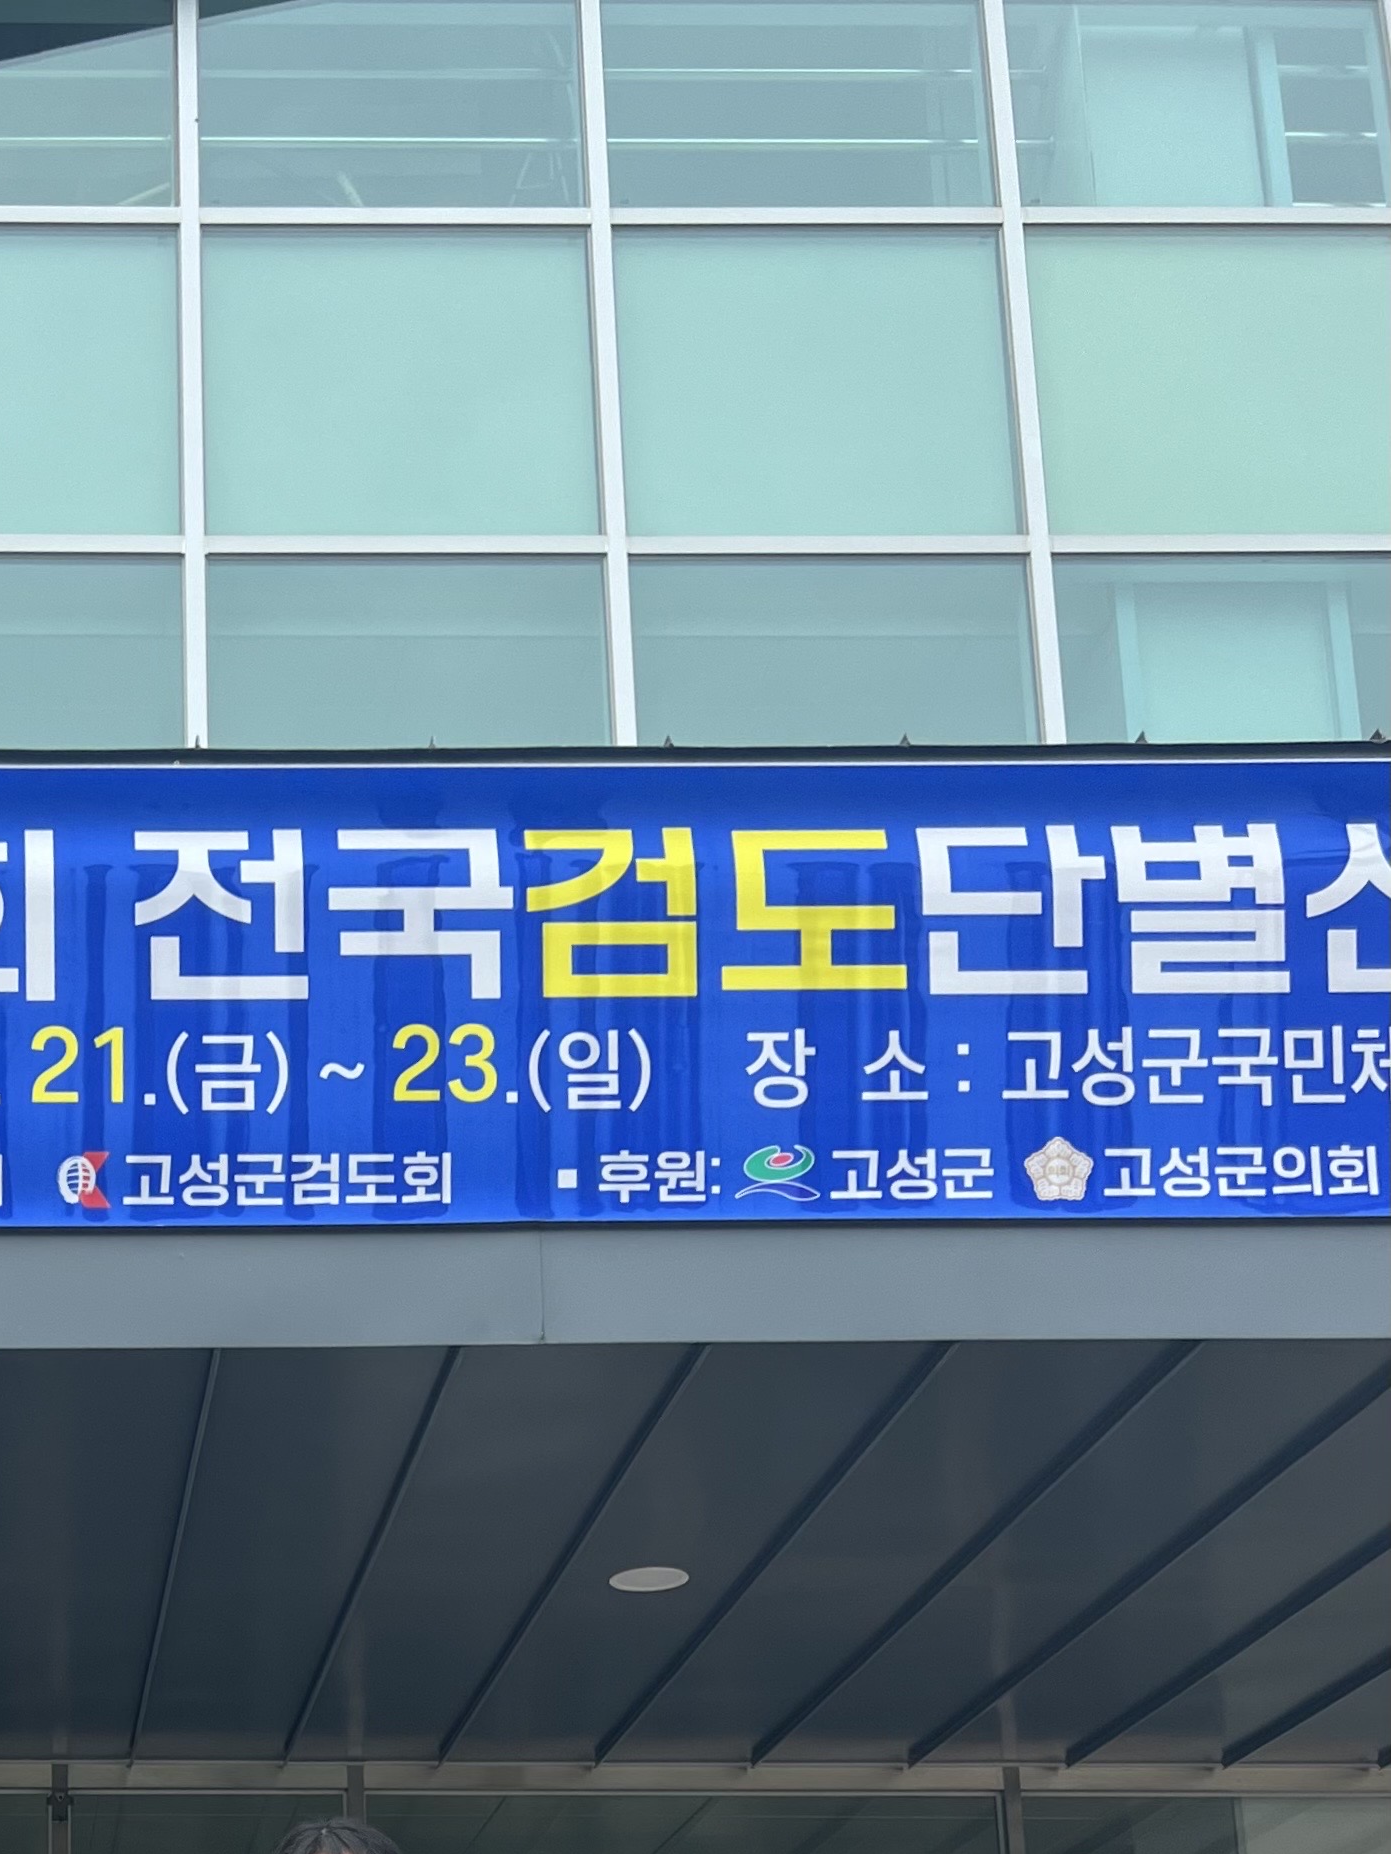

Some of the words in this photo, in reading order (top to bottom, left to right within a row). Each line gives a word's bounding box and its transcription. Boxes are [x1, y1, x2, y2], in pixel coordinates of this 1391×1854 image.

[31, 1026, 288, 1114] 21.(금)
[393, 1024, 650, 1111] 23.(일)
[124, 1152, 451, 1206] 고성군검도회
[831, 1149, 993, 1199] 고성군
[1104, 1145, 1378, 1196] 고성군의회
